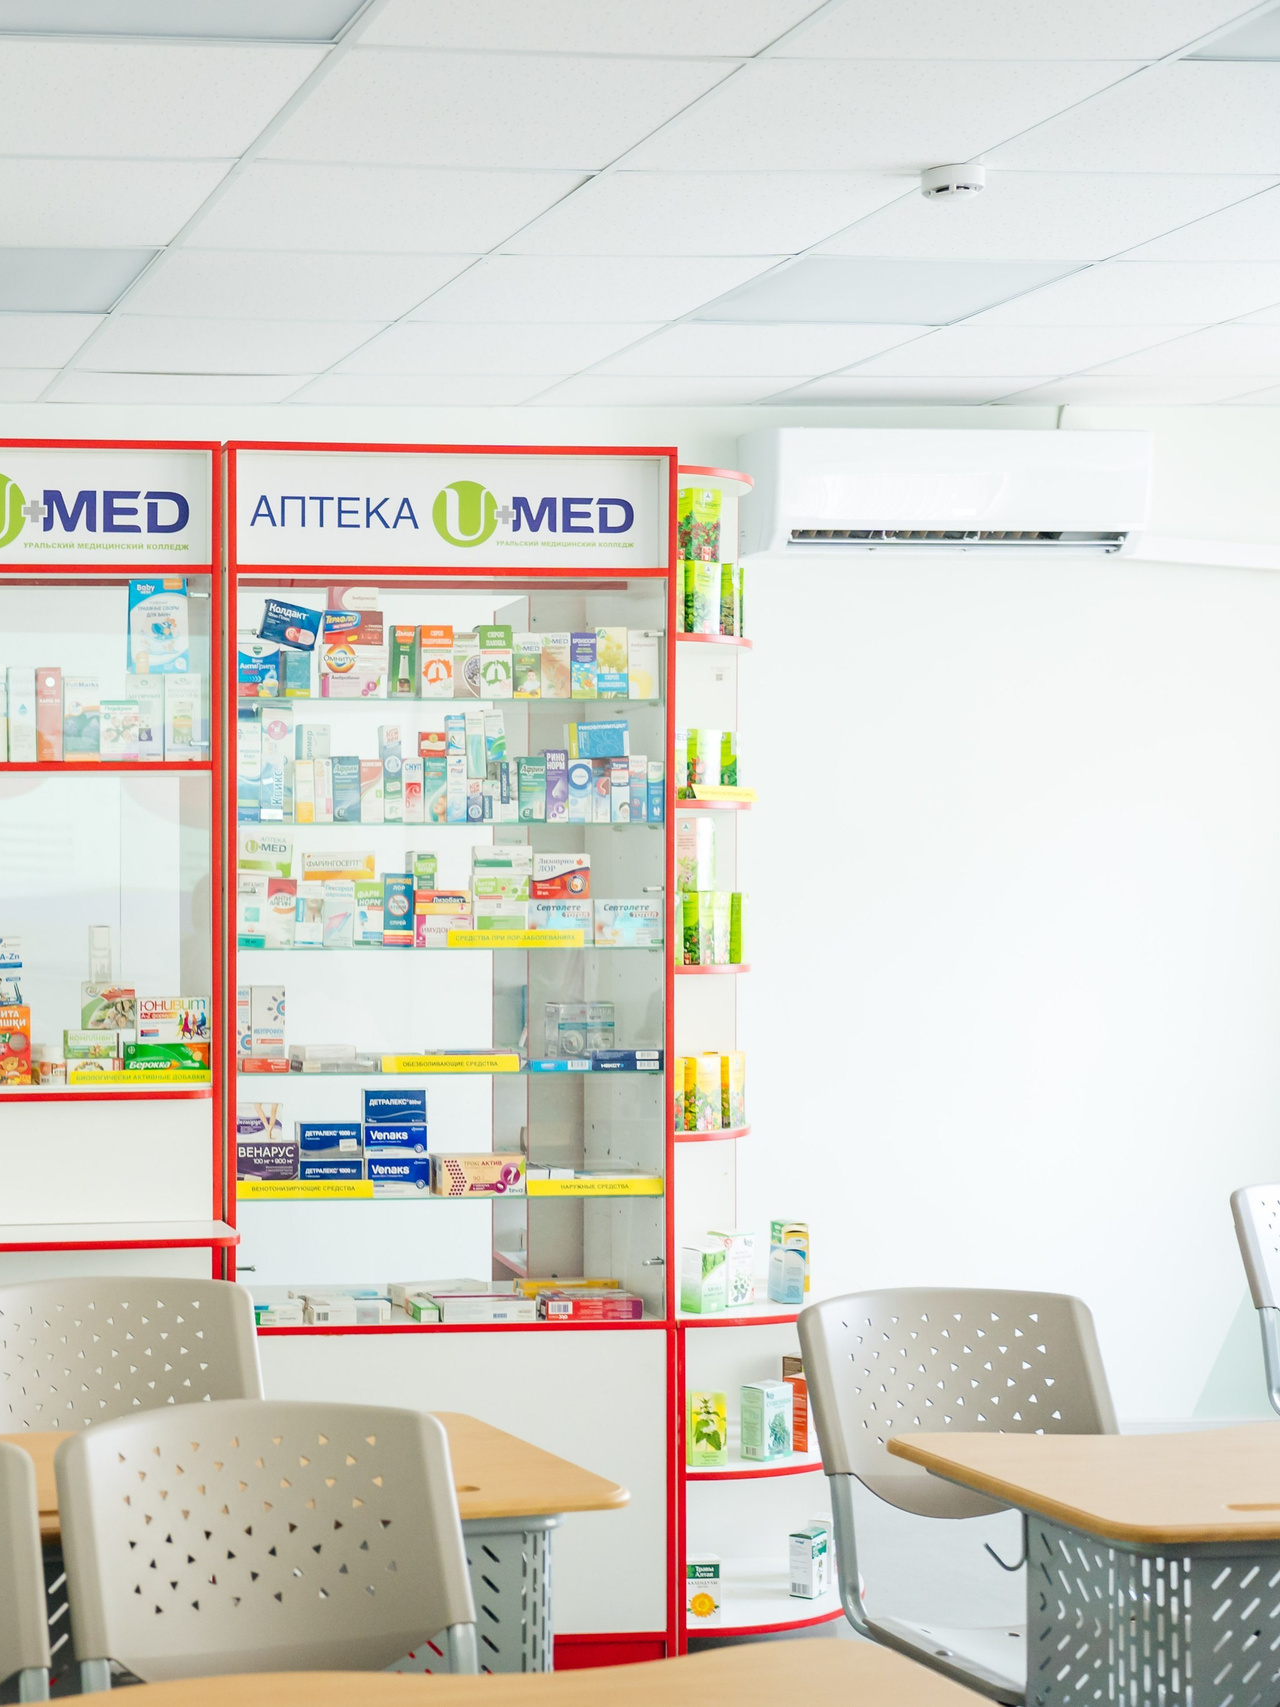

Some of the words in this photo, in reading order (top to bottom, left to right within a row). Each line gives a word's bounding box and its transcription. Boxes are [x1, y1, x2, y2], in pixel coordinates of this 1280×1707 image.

[250, 495, 419, 529] АПТЕКА
[23, 542, 76, 550] УРАЛЬСКИЙ
[77, 542, 144, 550] МЕДИЦИНСКИЙ
[540, 540, 597, 548] МЕДИЦИНСКИЙ
[269, 603, 307, 620] Колдакт
[239, 663, 276, 671] АнтиГрипп
[546, 761, 566, 770] НОРМ
[306, 859, 358, 867] ФАРИНГОСЕПТ
[536, 903, 581, 912] Септолете
[603, 903, 649, 912] Септолете
[0, 953, 20, 961] A-Zn
[129, 1061, 171, 1070] Берокка
[369, 1098, 407, 1107] ДЕТРАЛЕКС
[370, 1130, 409, 1140] Venaks
[238, 1146, 295, 1158] ВЕНАРУС
[371, 1164, 410, 1175] Venaks
